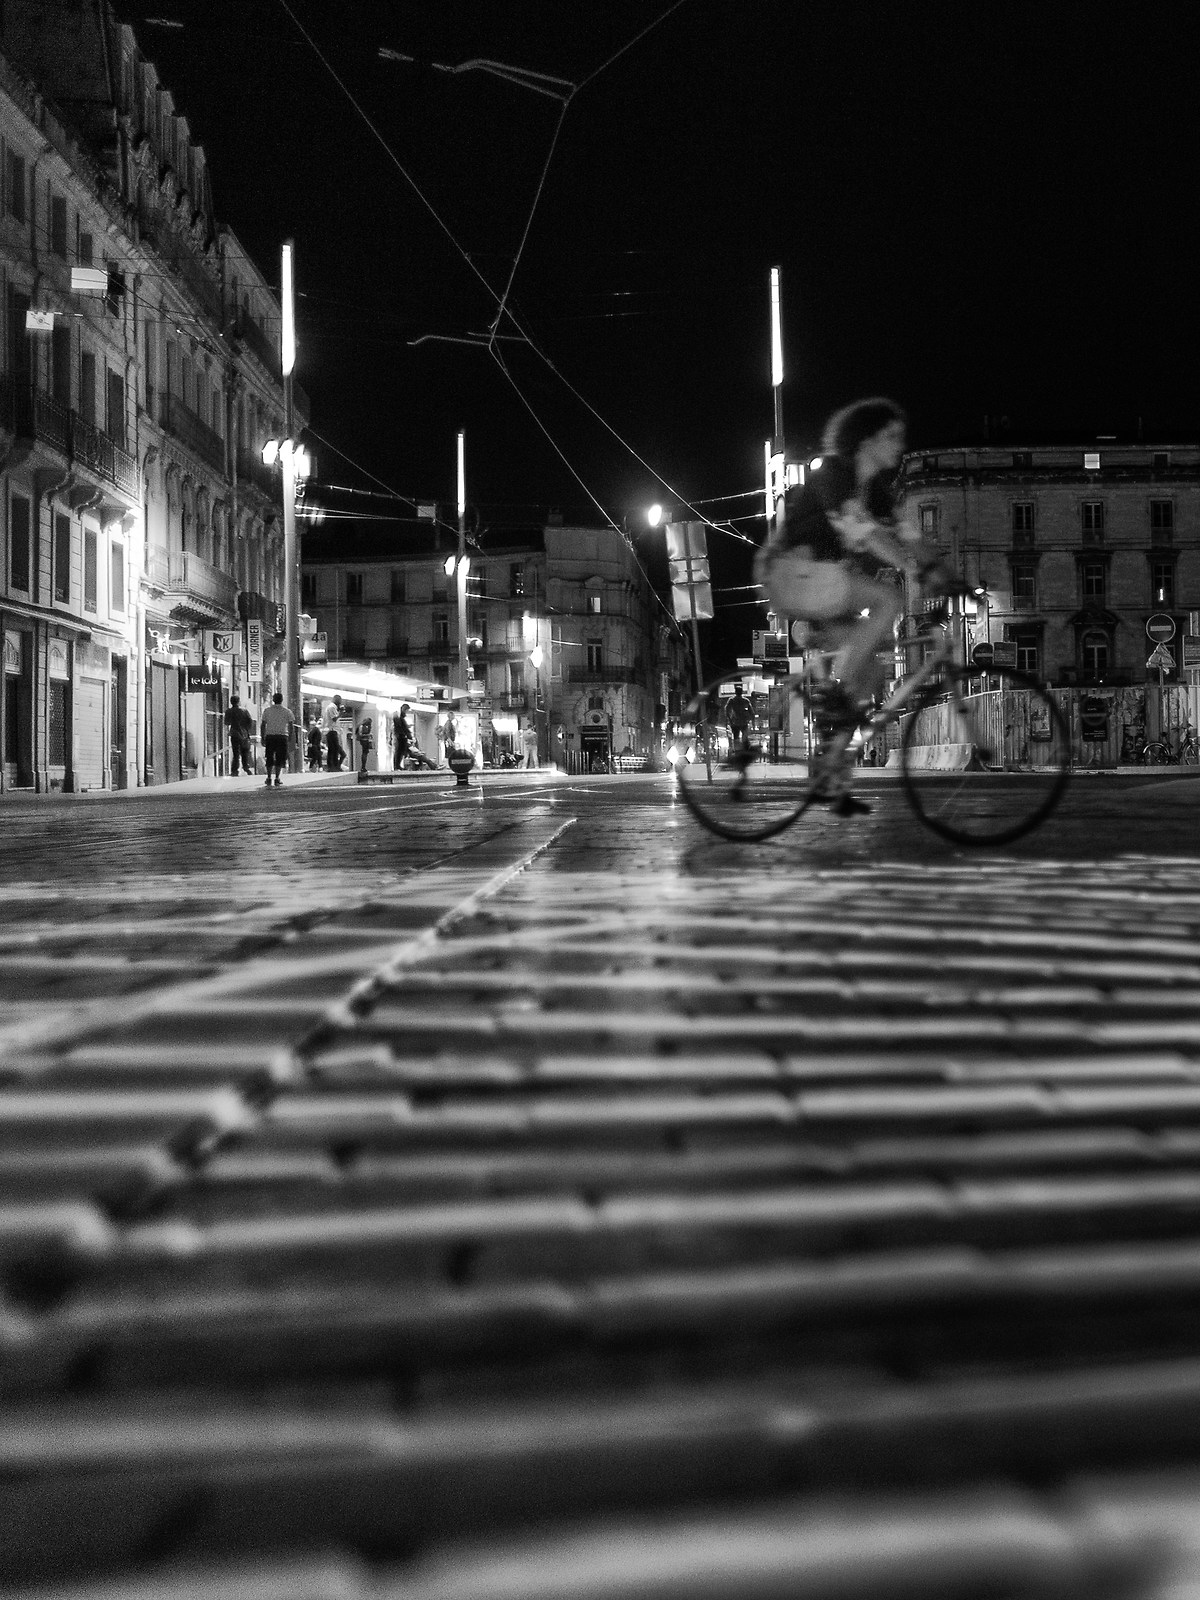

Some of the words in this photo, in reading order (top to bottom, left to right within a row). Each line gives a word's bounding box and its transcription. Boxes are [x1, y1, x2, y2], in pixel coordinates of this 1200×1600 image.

[311, 633, 326, 643] 4a
[753, 631, 760, 640] 3
[250, 660, 260, 677] FOOT
